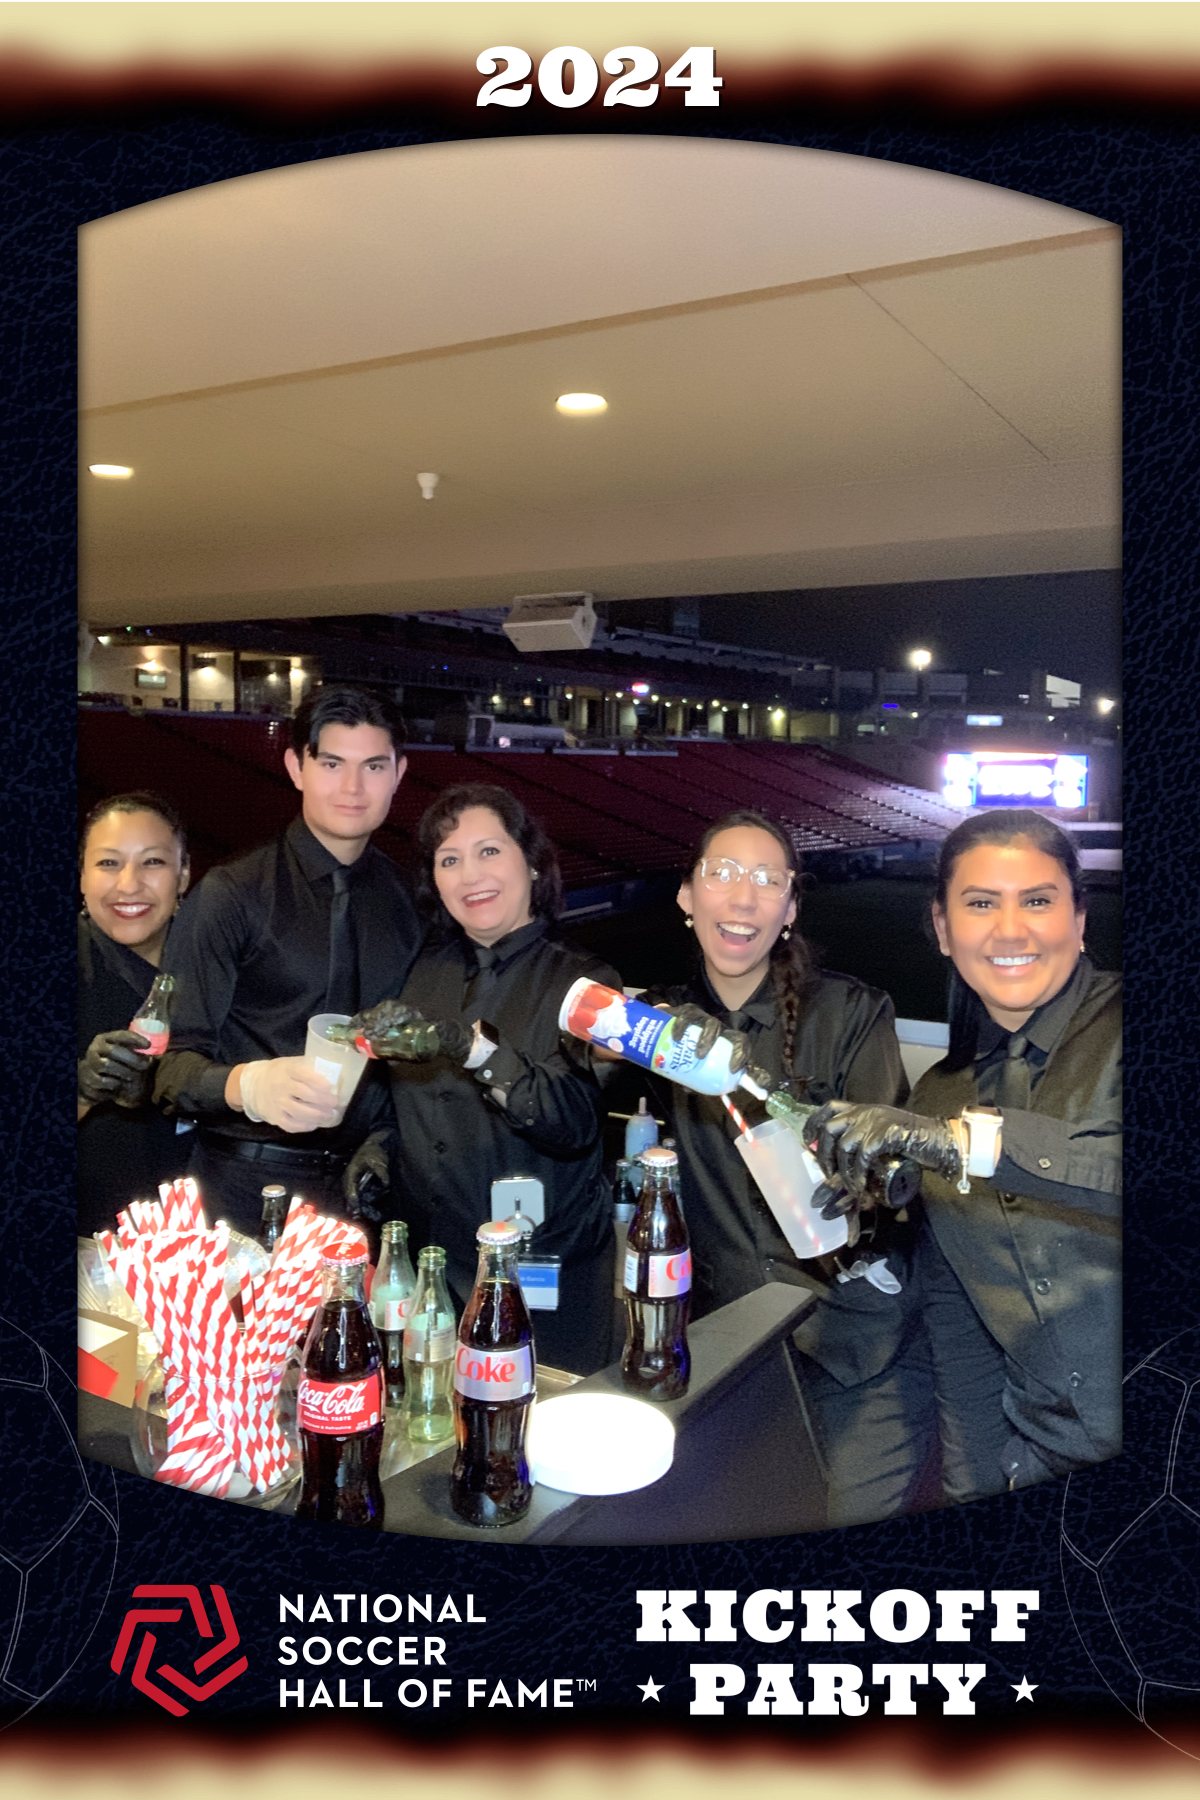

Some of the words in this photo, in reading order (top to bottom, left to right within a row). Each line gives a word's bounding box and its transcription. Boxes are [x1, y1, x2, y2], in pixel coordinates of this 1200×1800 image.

[628, 1017, 649, 1048] topping
[638, 1020, 657, 1054] whipped
[680, 1040, 697, 1067] Oak
[456, 1347, 516, 1383] Coke
[298, 1379, 368, 1415] Coca-Cola
[303, 1410, 329, 1421] ORIGINAL
